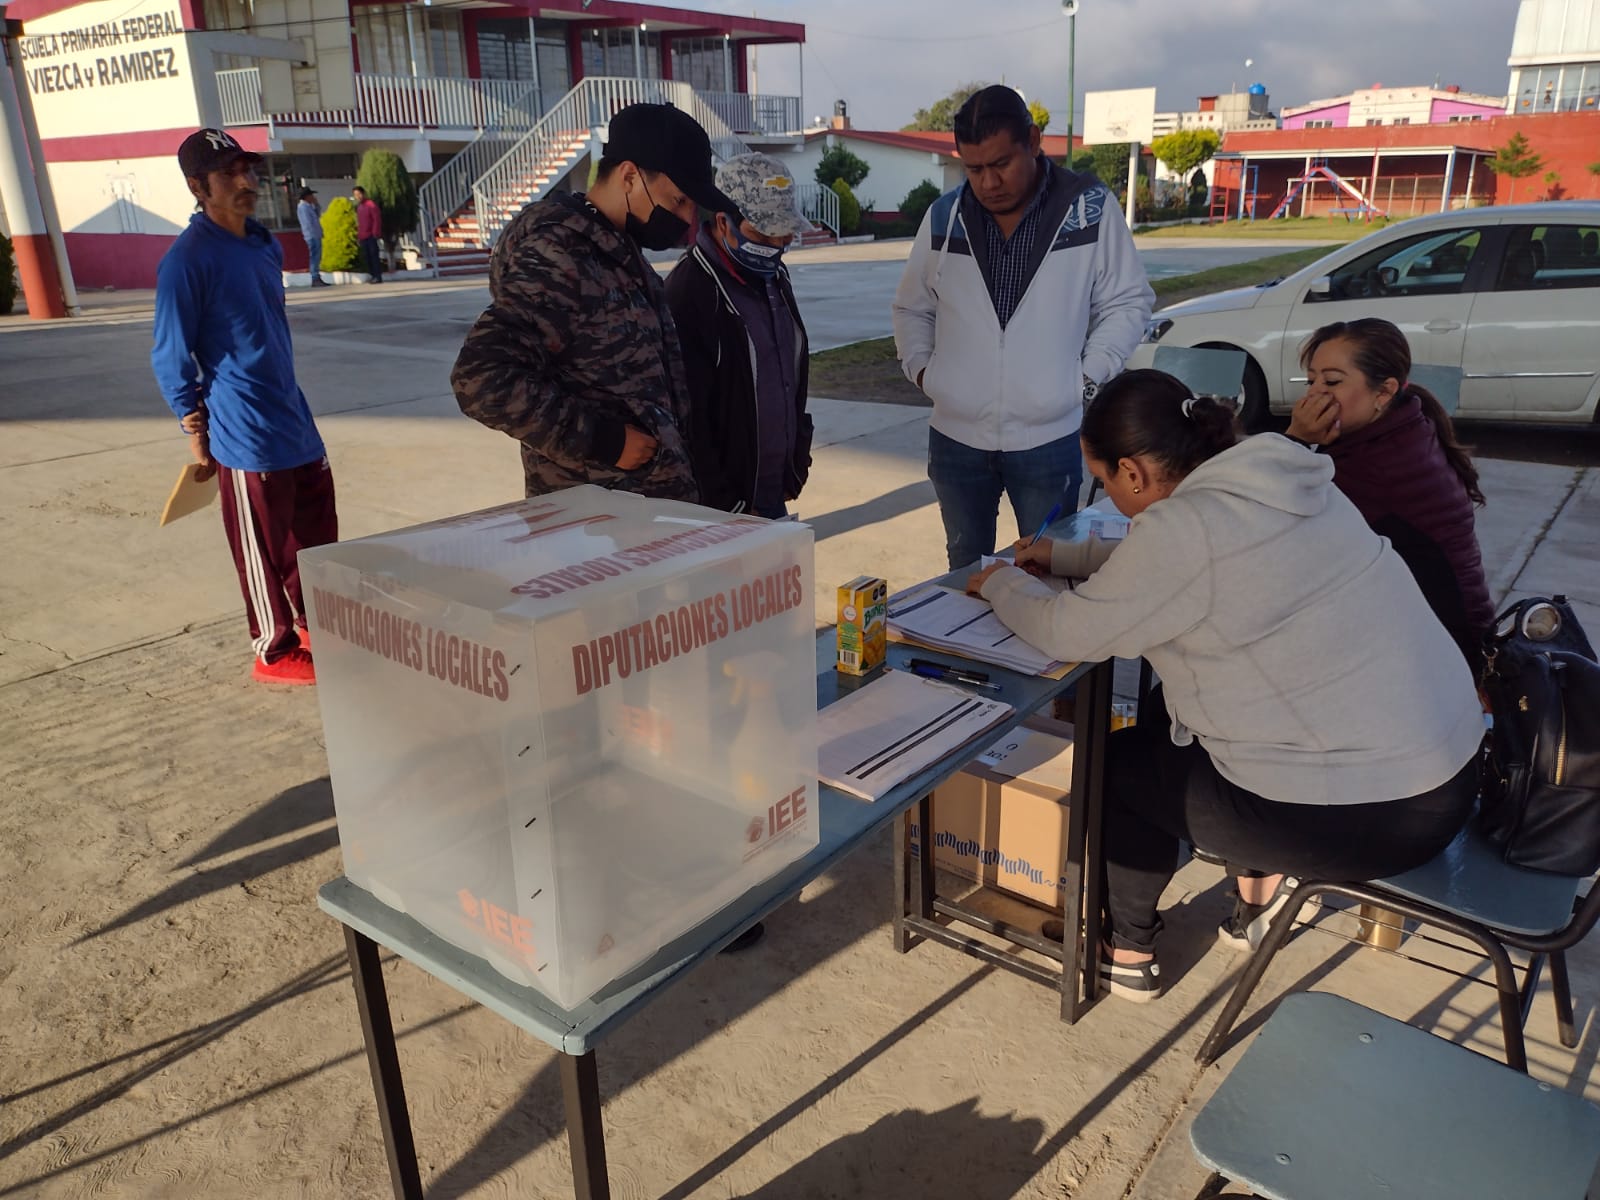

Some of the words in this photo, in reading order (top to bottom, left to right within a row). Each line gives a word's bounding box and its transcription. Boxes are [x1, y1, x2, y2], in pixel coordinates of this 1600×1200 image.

[20, 35, 60, 60] SCUELA
[62, 22, 122, 53] PRIMARIA
[122, 10, 183, 43] FEDERAL
[27, 62, 84, 94] VIEZCA
[96, 48, 179, 86] RAMIREZ
[312, 586, 423, 672] DIPUTACIONES
[427, 628, 510, 702] LOCALES
[572, 602, 729, 695] DIPUTACIONES
[733, 563, 803, 634] LOCALES
[768, 784, 807, 837] IEE
[480, 898, 537, 954] IEE
